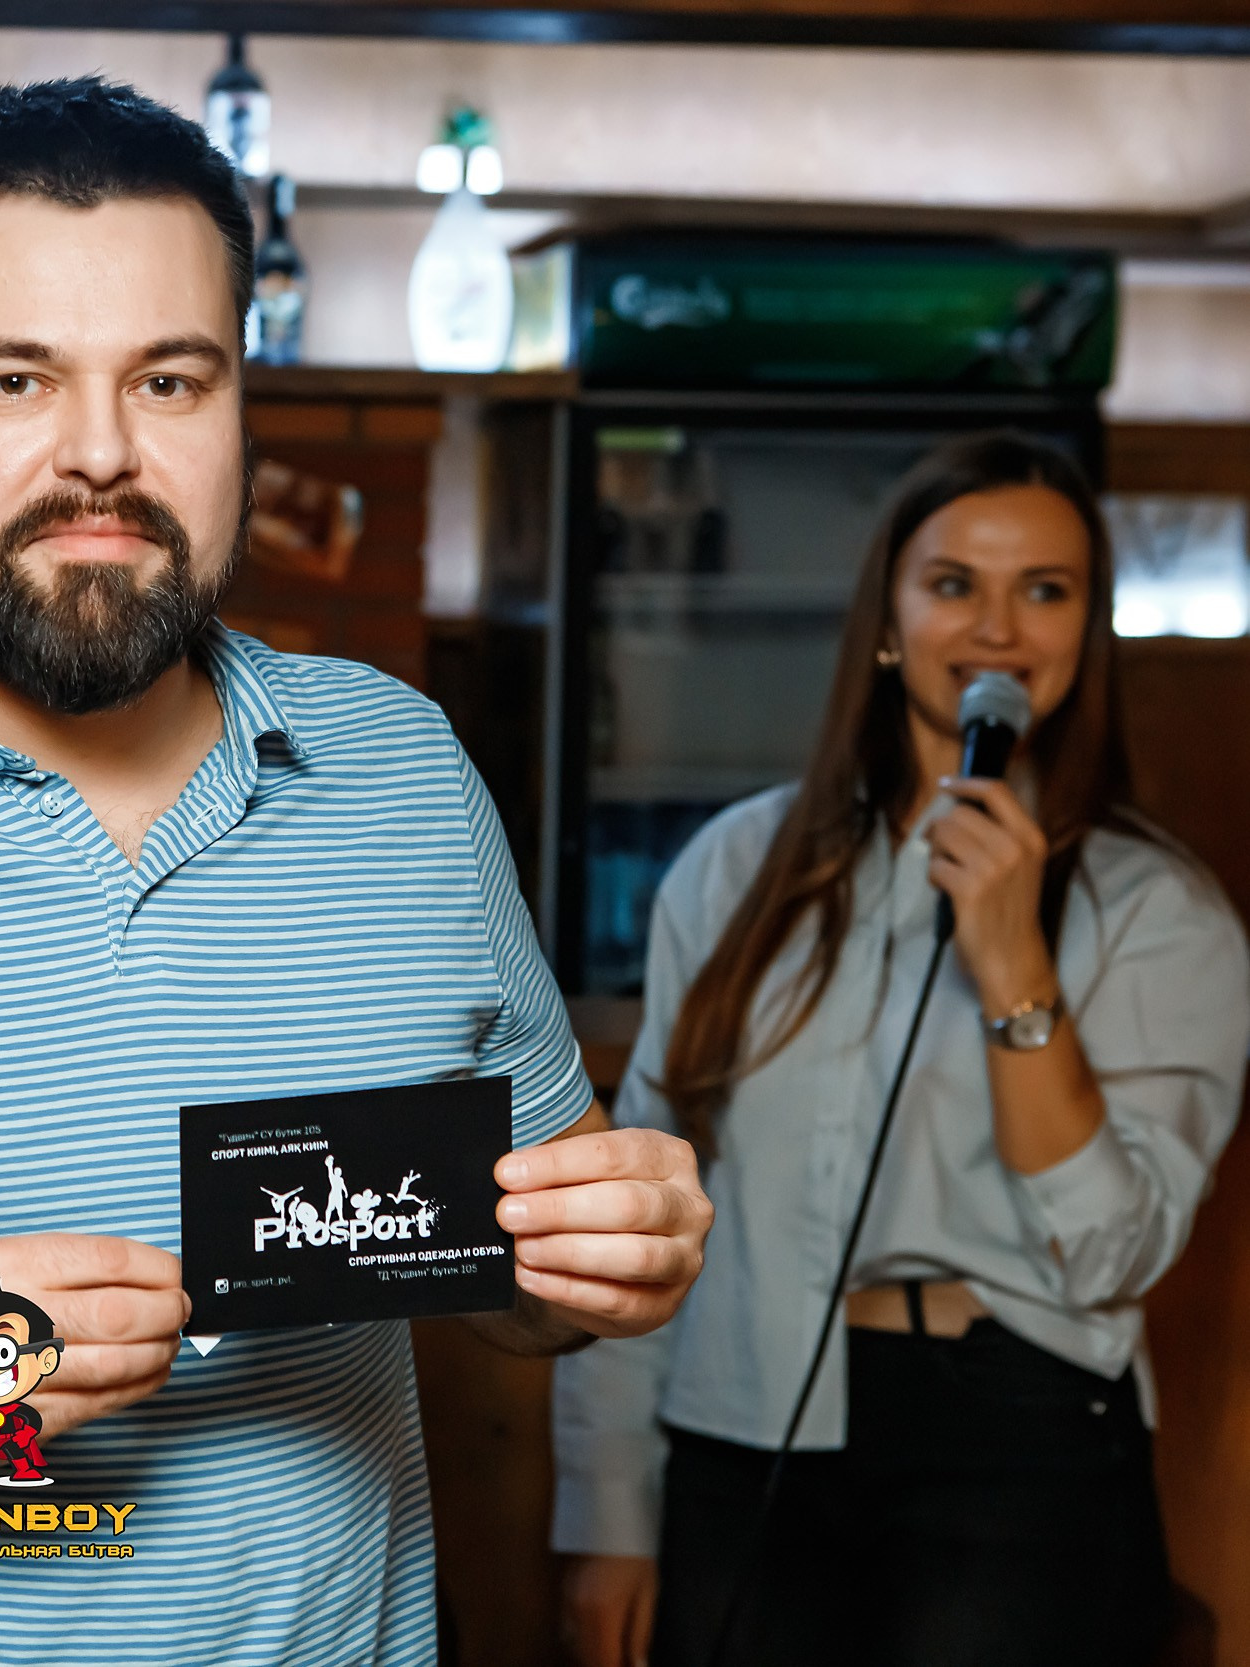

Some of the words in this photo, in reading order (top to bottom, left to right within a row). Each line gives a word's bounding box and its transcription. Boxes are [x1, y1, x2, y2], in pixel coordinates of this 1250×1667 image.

[275, 1128, 302, 1139] бутик
[304, 1125, 321, 1136] 105
[211, 1147, 246, 1161] СПОРТ
[348, 1253, 417, 1267] СПОРТИВНАЯ
[417, 1248, 462, 1262] ОДЕЖДА
[463, 1247, 471, 1257] И
[472, 1245, 505, 1257] ОБУВЬ
[432, 1266, 459, 1278] бутик
[461, 1264, 478, 1274] 105
